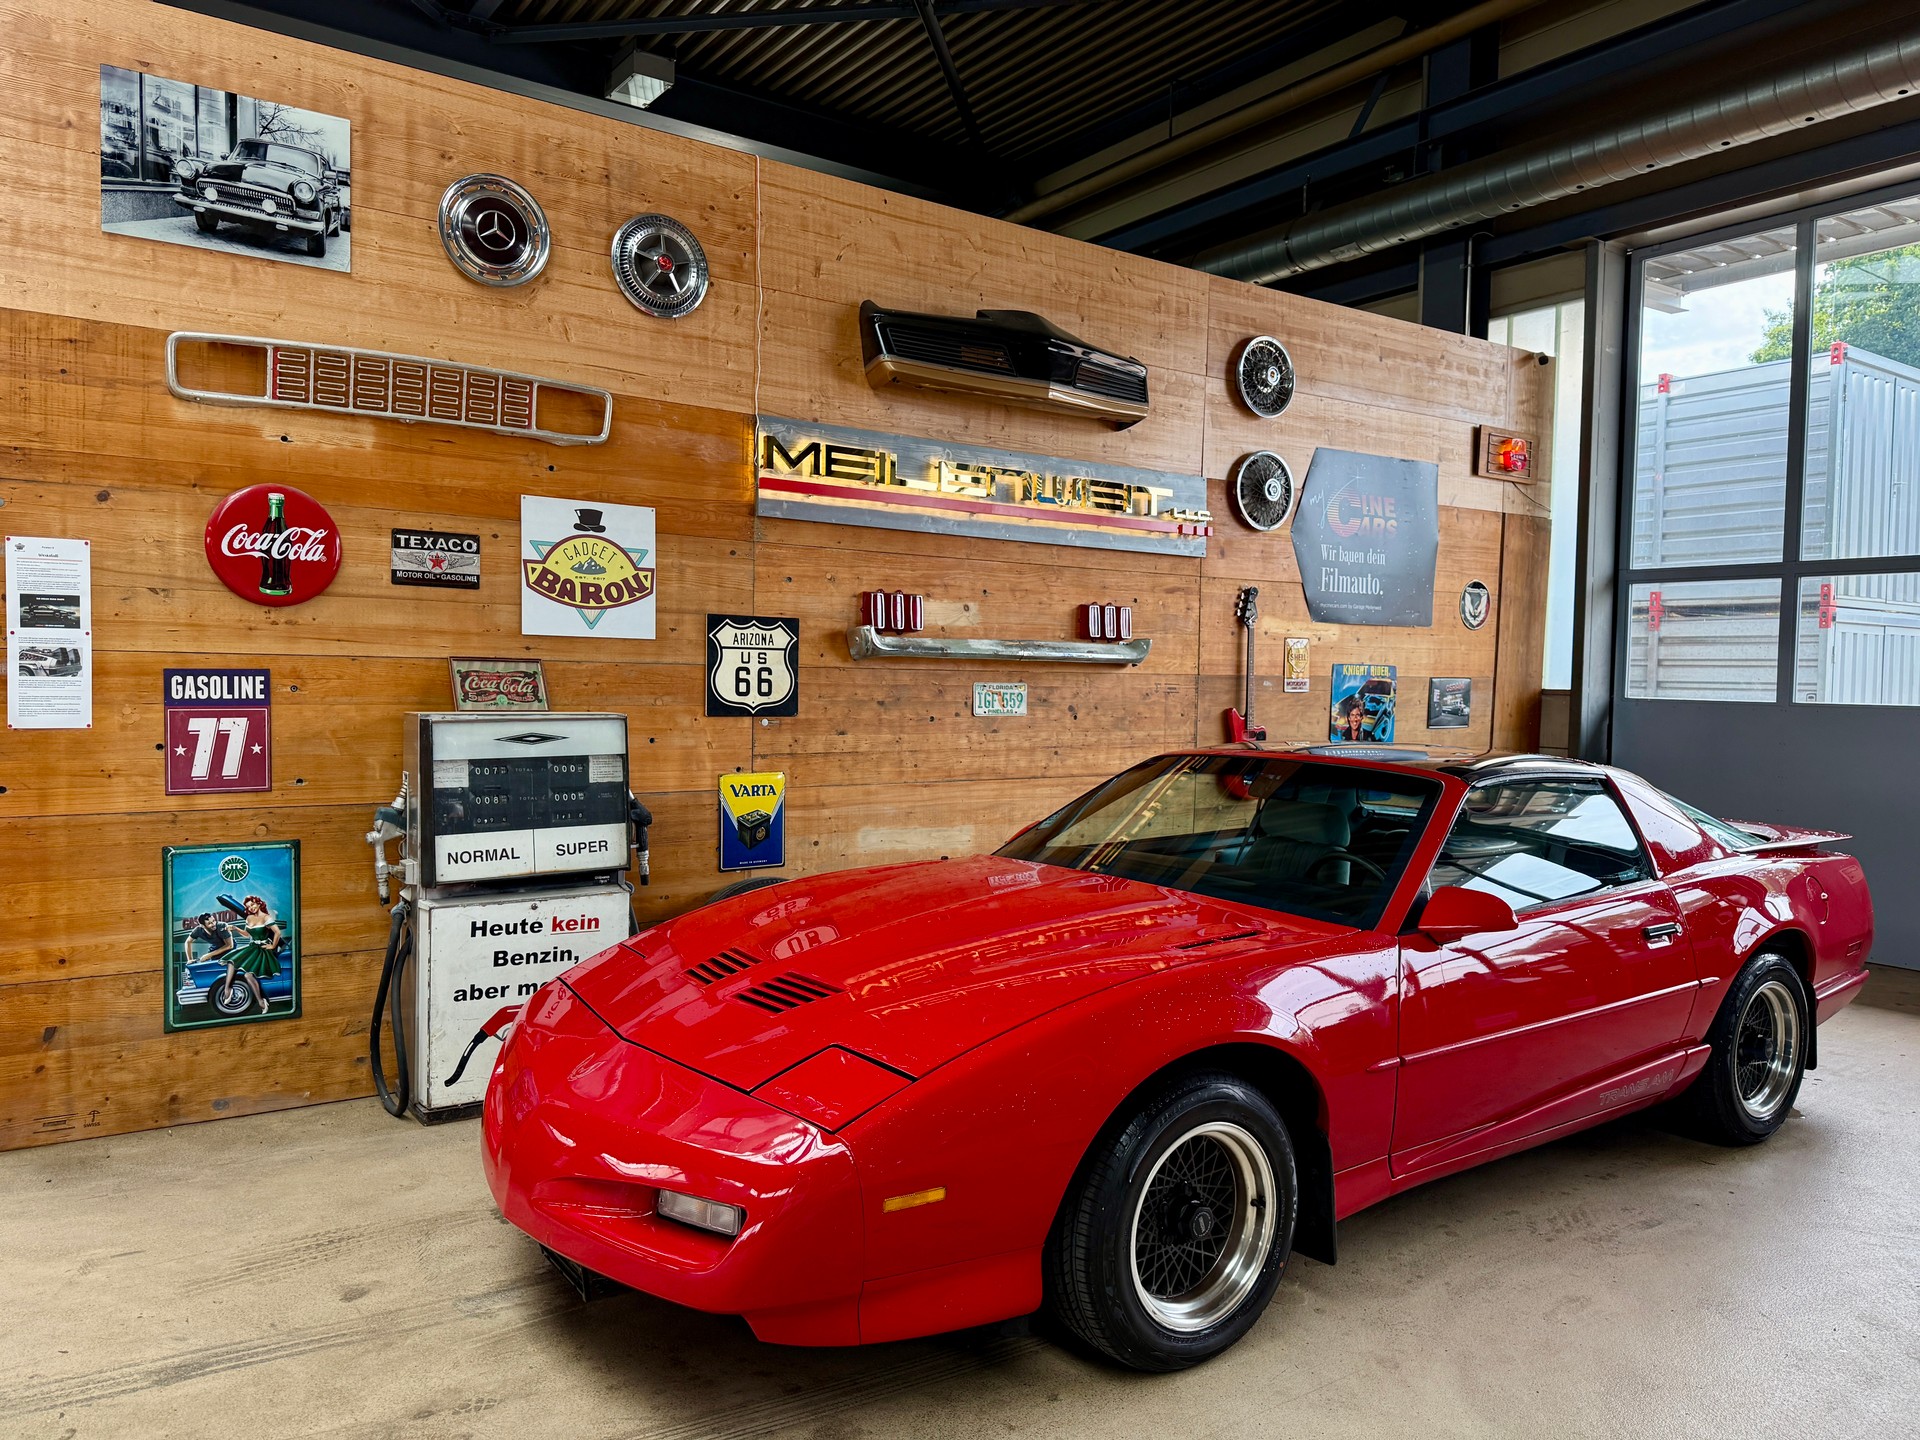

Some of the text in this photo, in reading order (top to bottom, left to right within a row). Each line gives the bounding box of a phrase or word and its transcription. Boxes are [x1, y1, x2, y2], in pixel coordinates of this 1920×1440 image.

[221, 523, 328, 563] Coca-Cola
[396, 534, 477, 553] TEXACO
[563, 542, 618, 564] GADGET
[1321, 544, 1386, 565] Wir bauen dein
[396, 570, 477, 583] MOTOR OIL GASOLINE
[532, 566, 649, 604] BARON
[1320, 567, 1384, 595] Filmauto.
[733, 632, 775, 646] ARIZONA
[1343, 664, 1369, 676] KNIGHT
[170, 675, 265, 700] GASOLINE
[464, 675, 535, 693] Coca-Cola
[734, 666, 772, 697] 66
[187, 717, 249, 780] 77
[730, 783, 777, 798] VARTA
[447, 839, 608, 865] NORMAL SUPER
[470, 914, 600, 938] Heute kein
[493, 945, 580, 968] Benzin,
[453, 984, 510, 1002] aber
